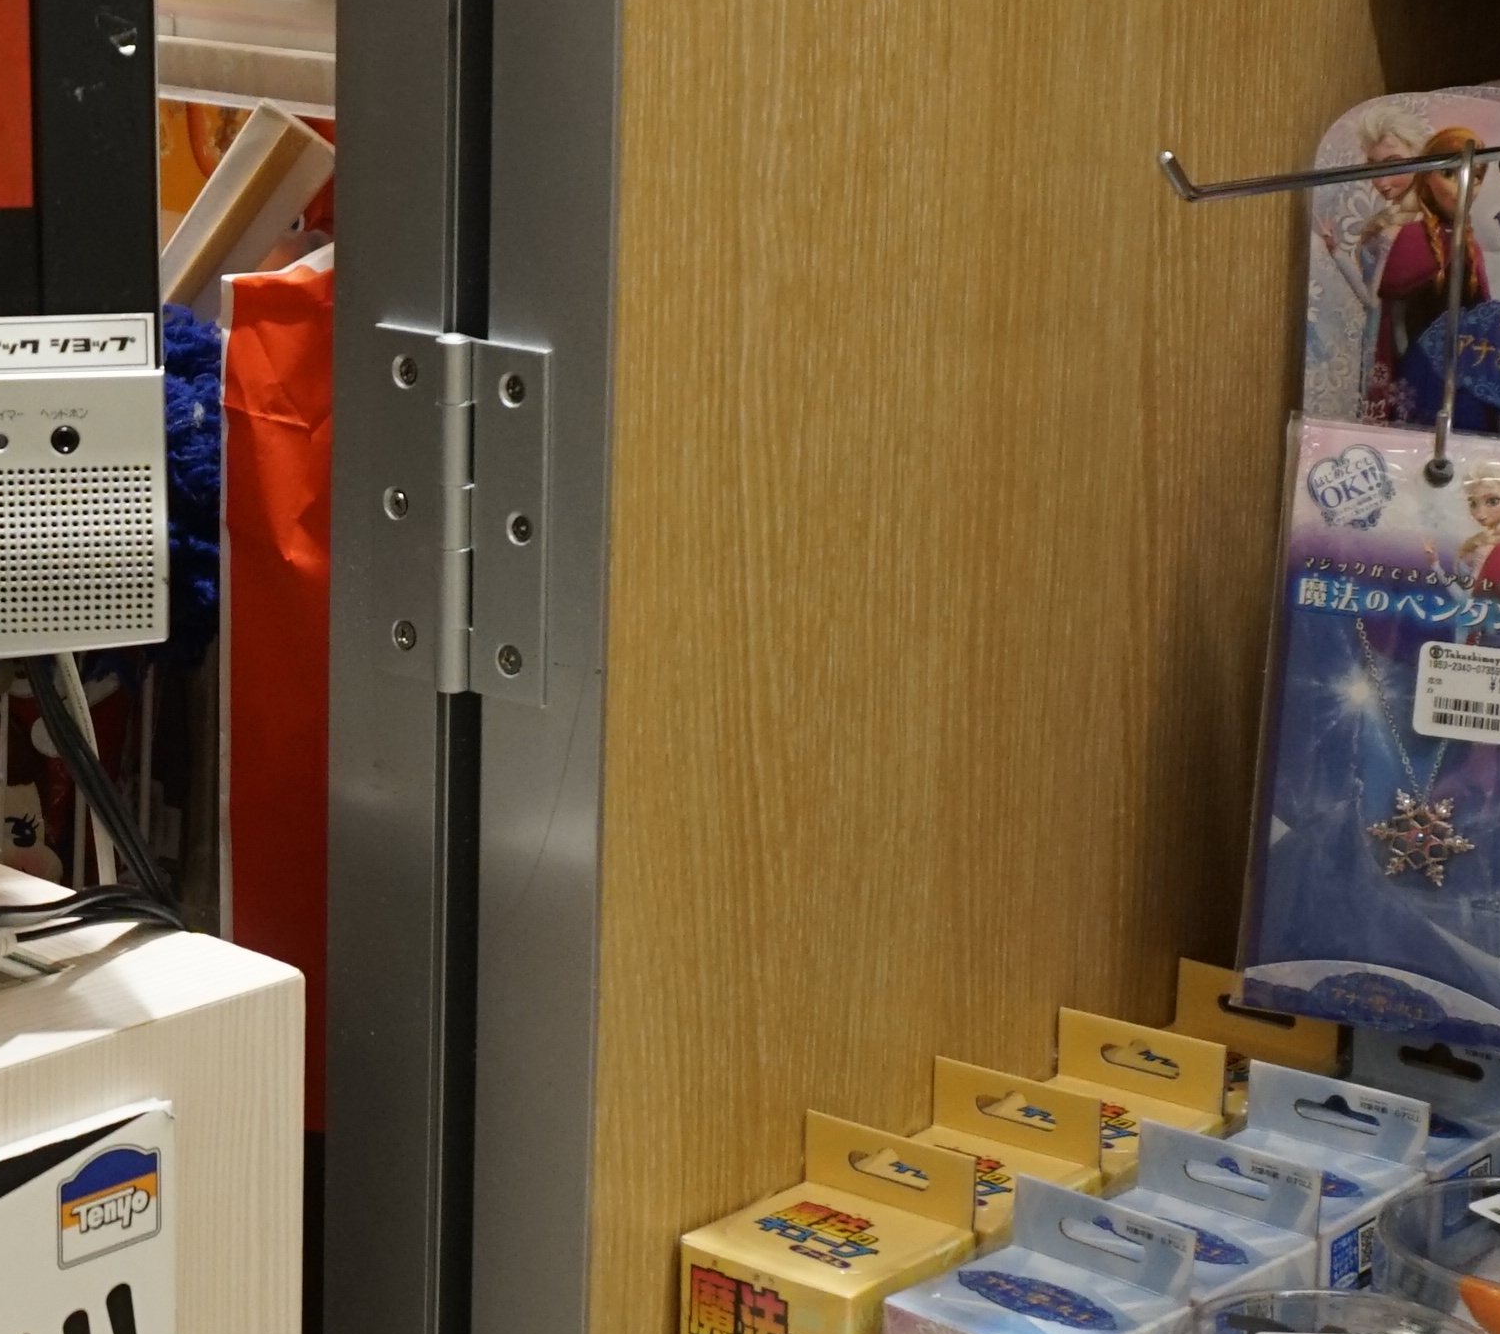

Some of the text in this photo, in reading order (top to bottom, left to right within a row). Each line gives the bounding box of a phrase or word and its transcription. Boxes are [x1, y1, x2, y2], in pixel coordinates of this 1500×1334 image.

[49, 336, 136, 356] ショップ
[69, 1185, 152, 1241] Tenyo
